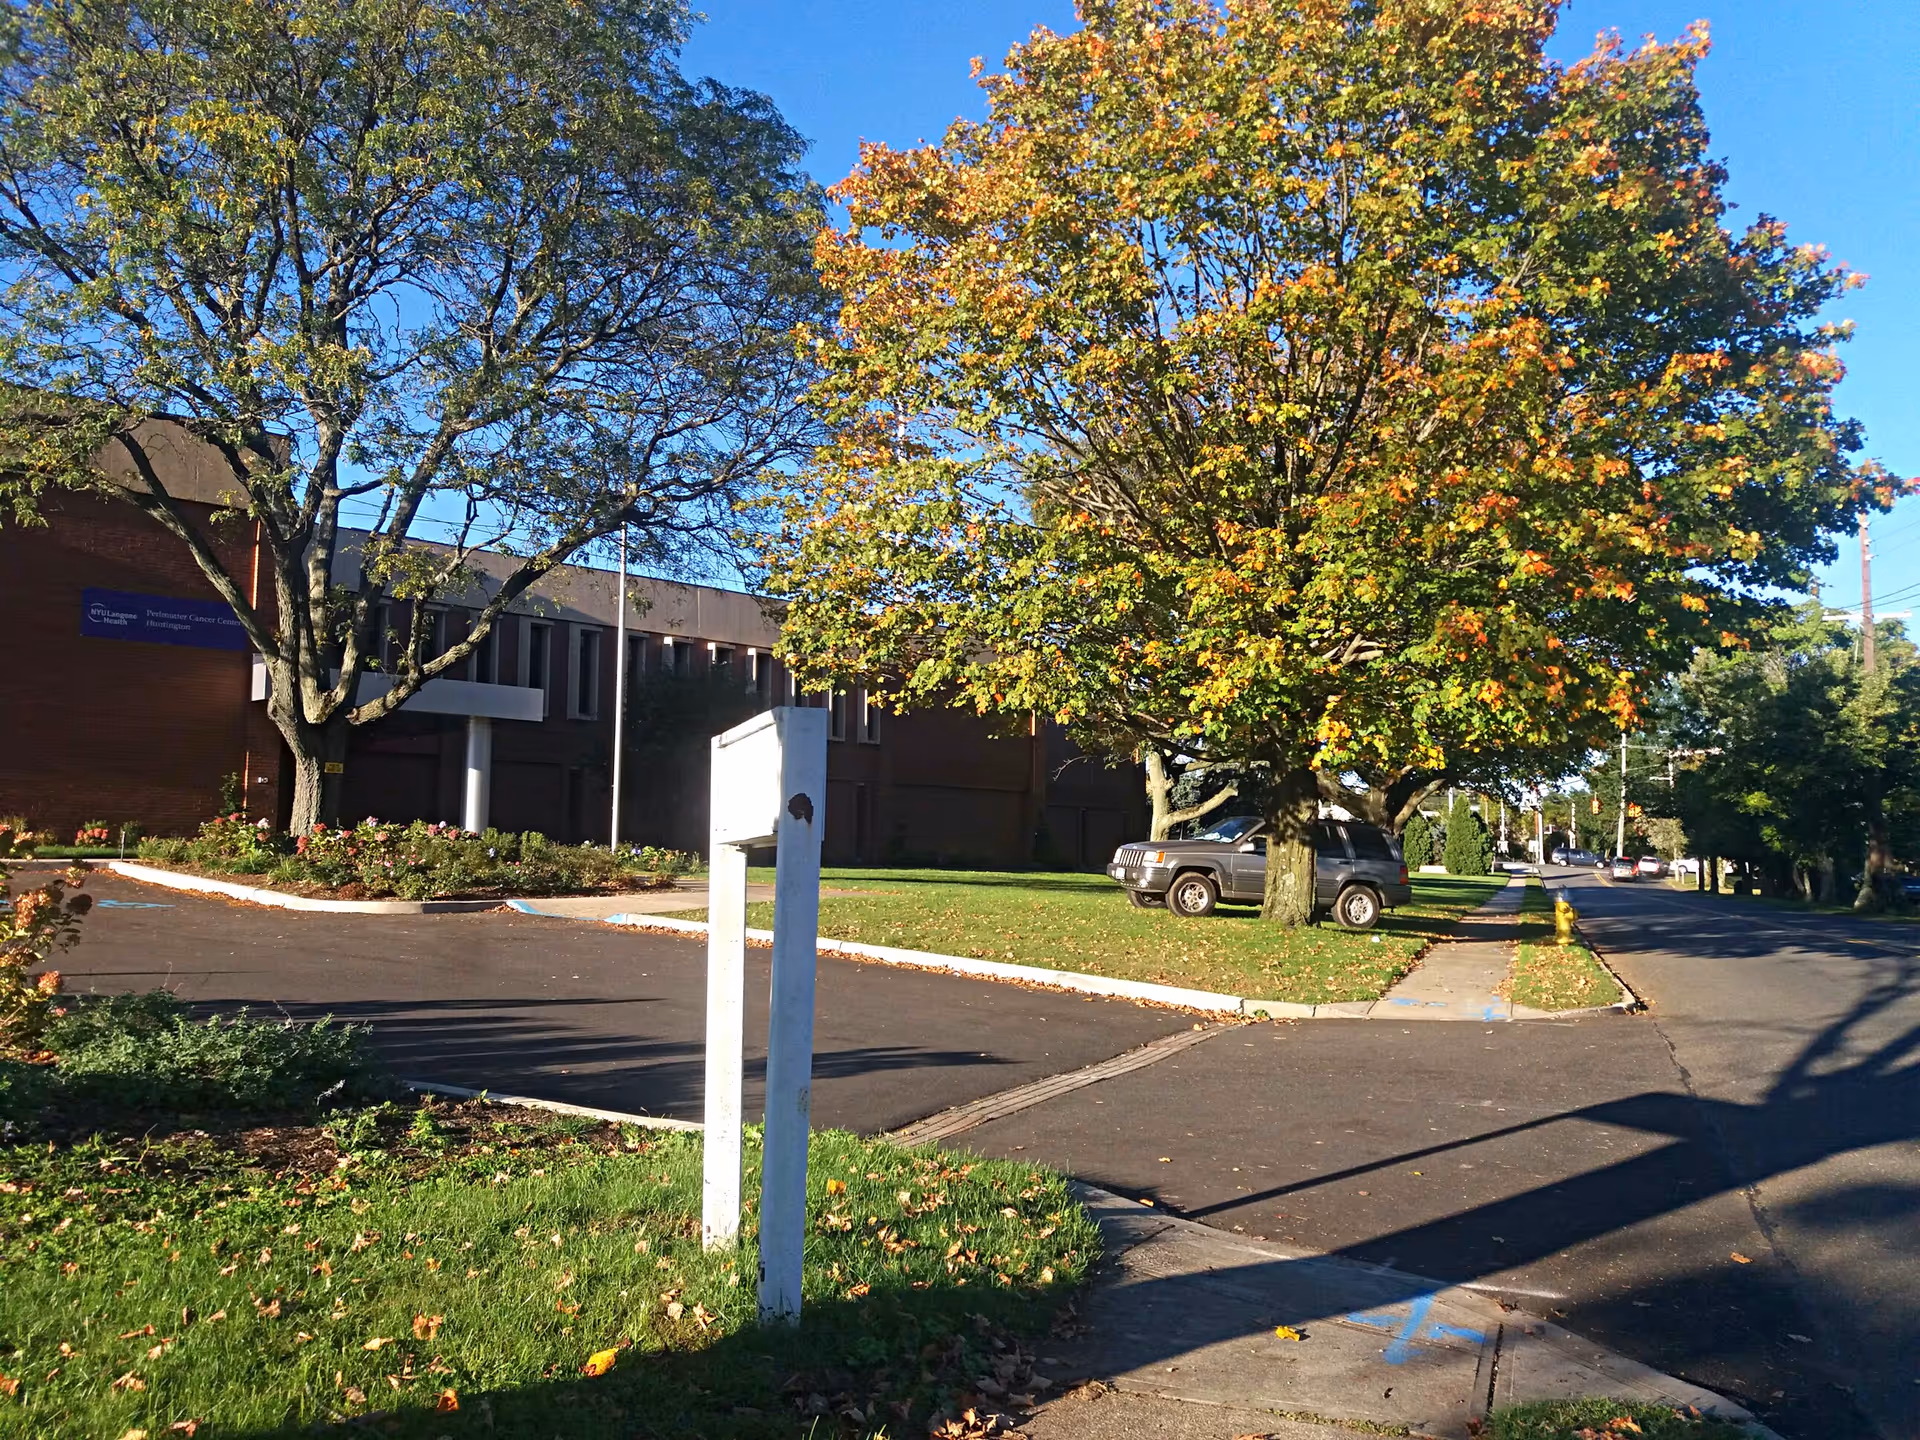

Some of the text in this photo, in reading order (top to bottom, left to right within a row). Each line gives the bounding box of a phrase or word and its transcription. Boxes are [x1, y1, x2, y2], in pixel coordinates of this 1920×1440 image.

[90, 608, 138, 621] NYU Langone
[146, 609, 242, 626] Perlmutter Cancer Center
[103, 617, 128, 626] Health
[146, 620, 191, 631] Huntington
